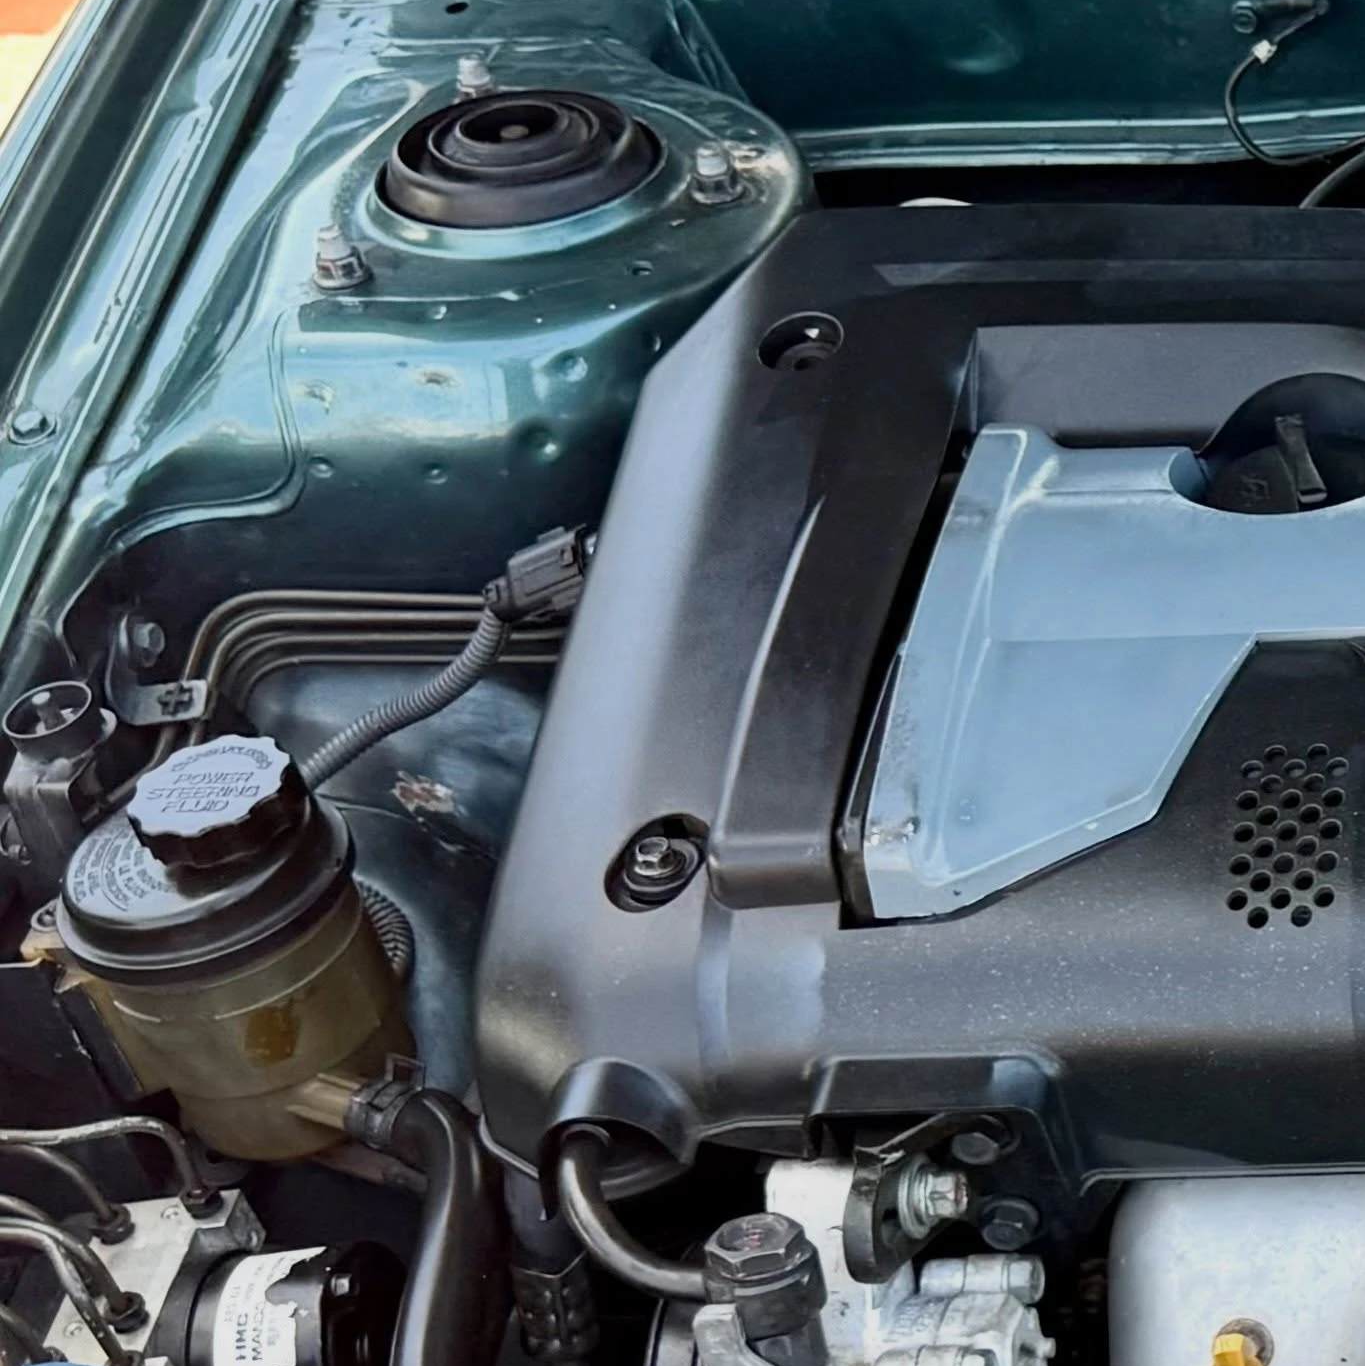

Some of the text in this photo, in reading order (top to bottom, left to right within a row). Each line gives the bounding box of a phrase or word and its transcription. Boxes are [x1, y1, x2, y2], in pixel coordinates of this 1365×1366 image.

[172, 771, 255, 786] POWER
[146, 784, 262, 801] STEERING
[160, 799, 231, 814] FLUID
